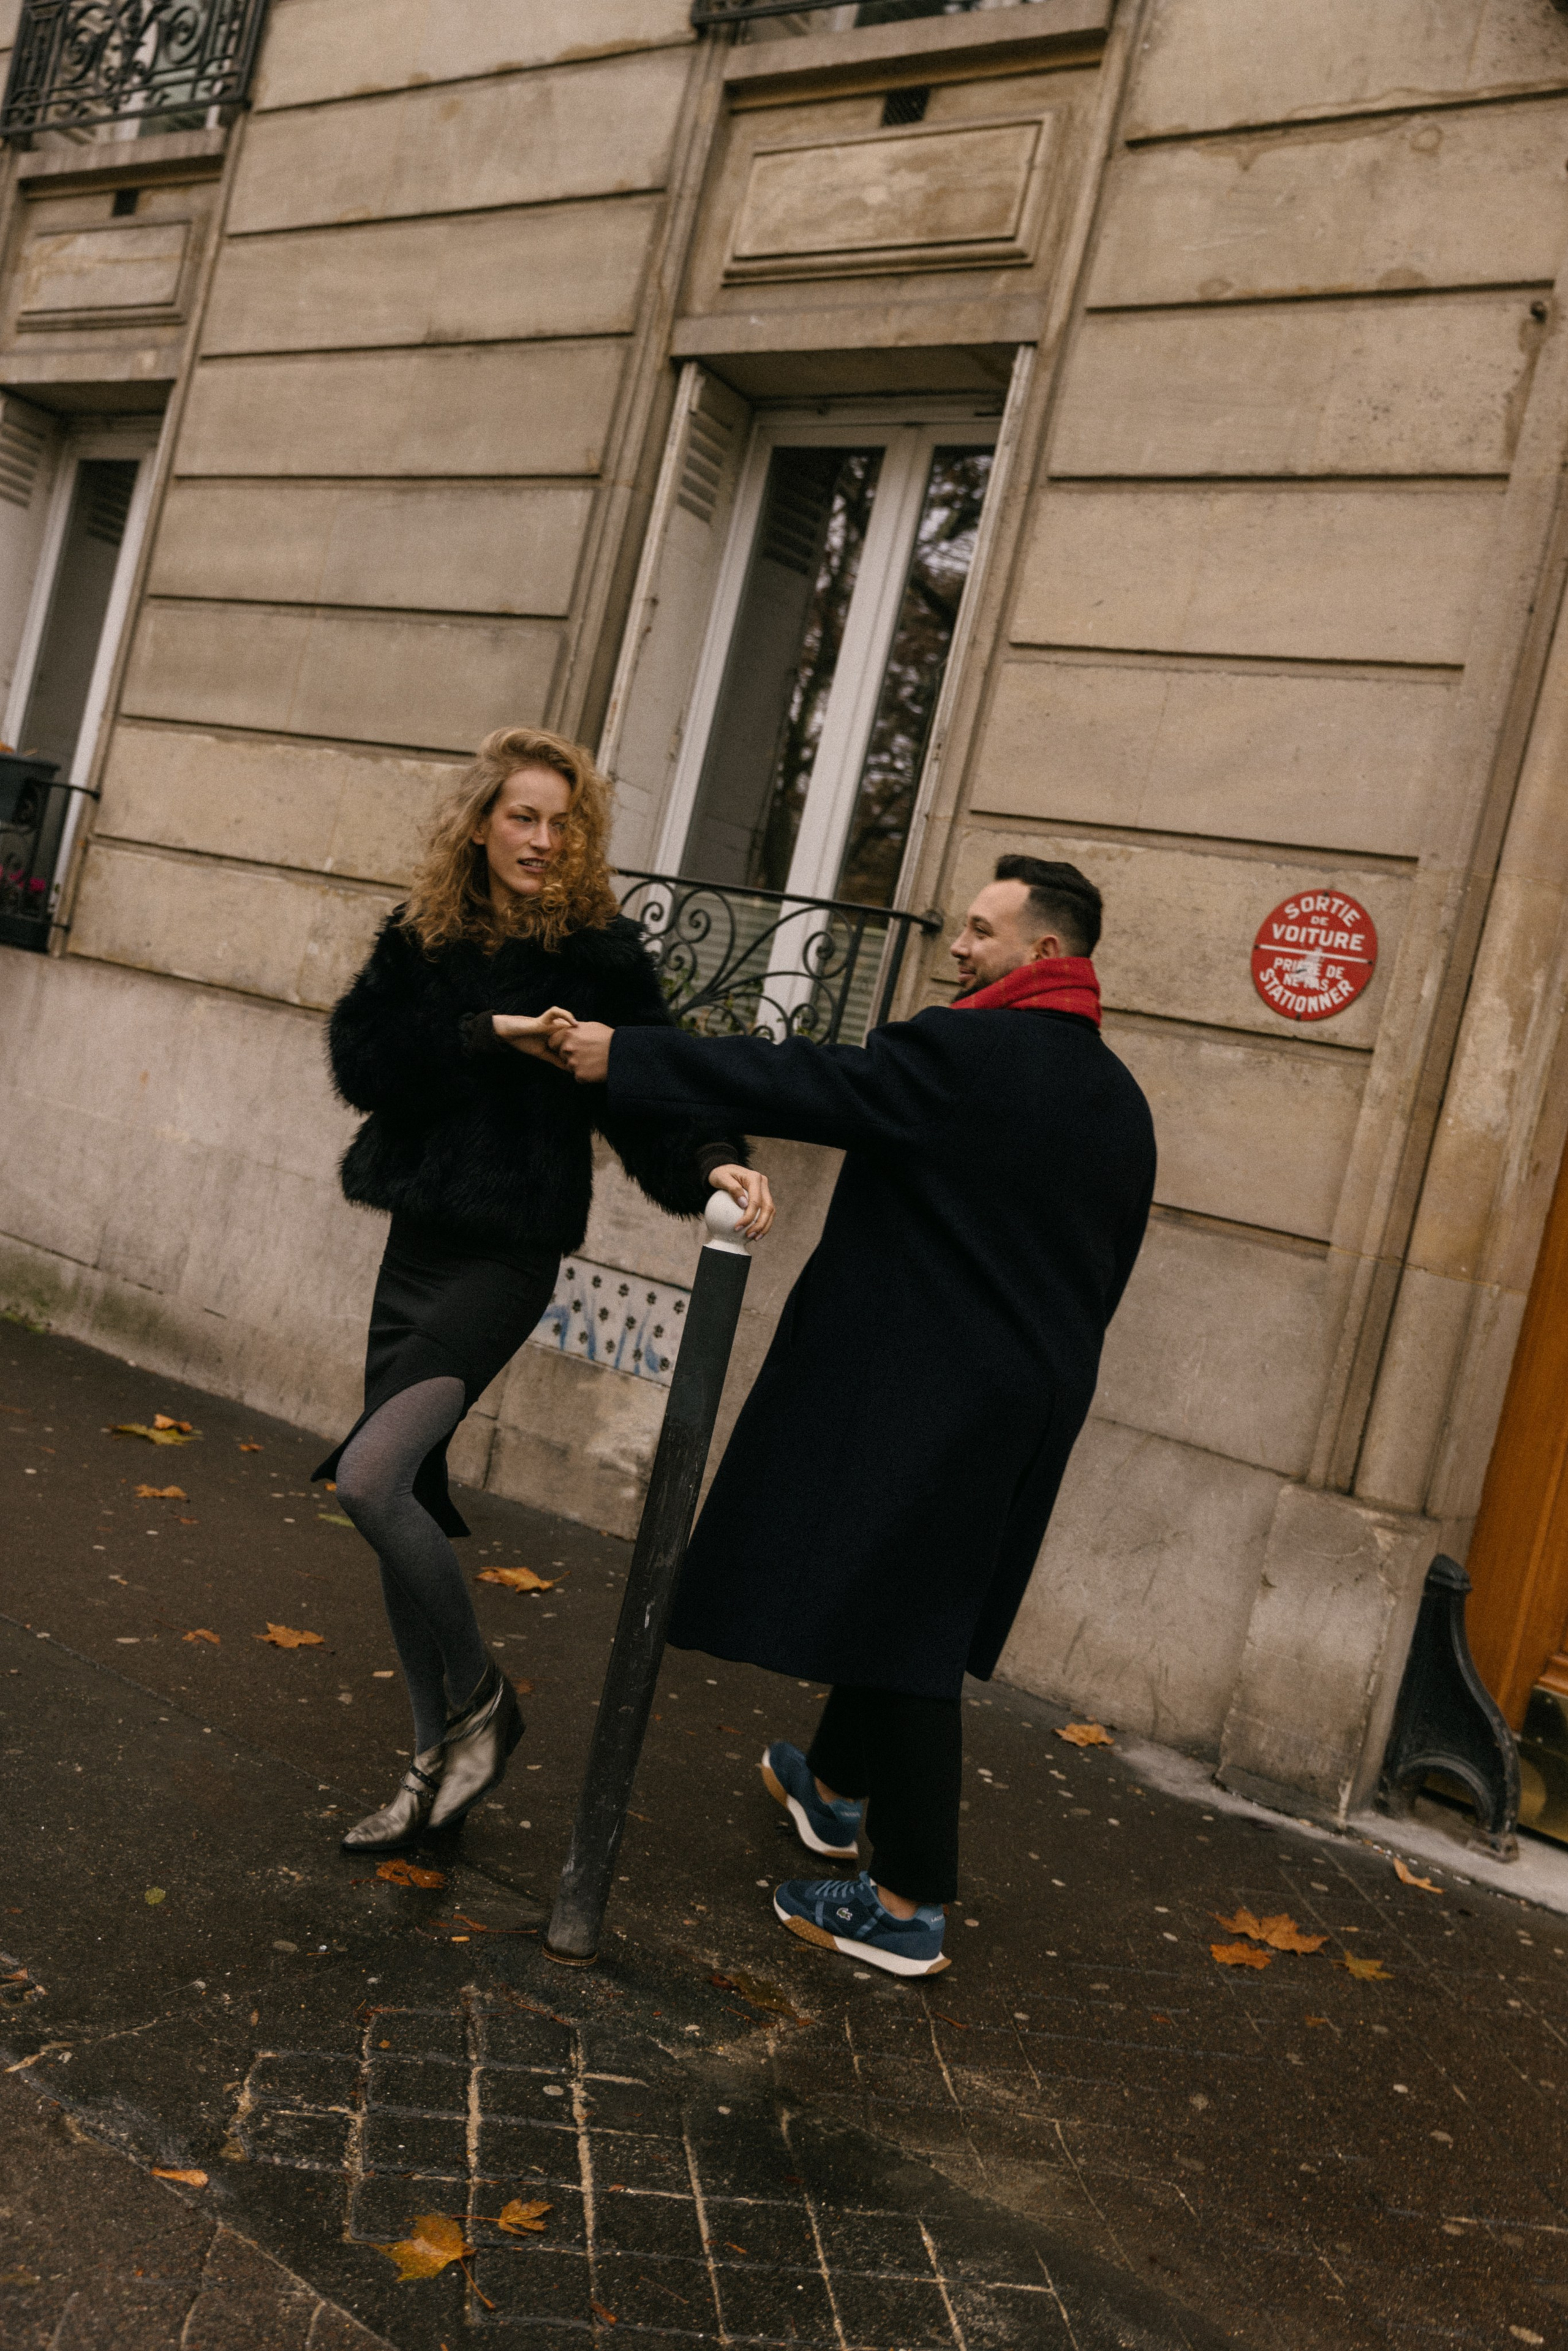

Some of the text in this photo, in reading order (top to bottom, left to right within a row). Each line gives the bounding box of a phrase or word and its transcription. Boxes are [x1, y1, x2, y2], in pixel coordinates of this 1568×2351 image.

[1284, 896, 1362, 927] SORTIE
[1310, 916, 1329, 926] DE
[1272, 923, 1365, 951] VOITURE
[1273, 957, 1345, 980] PRIE DE
[1259, 968, 1354, 1013] STATIONNER
